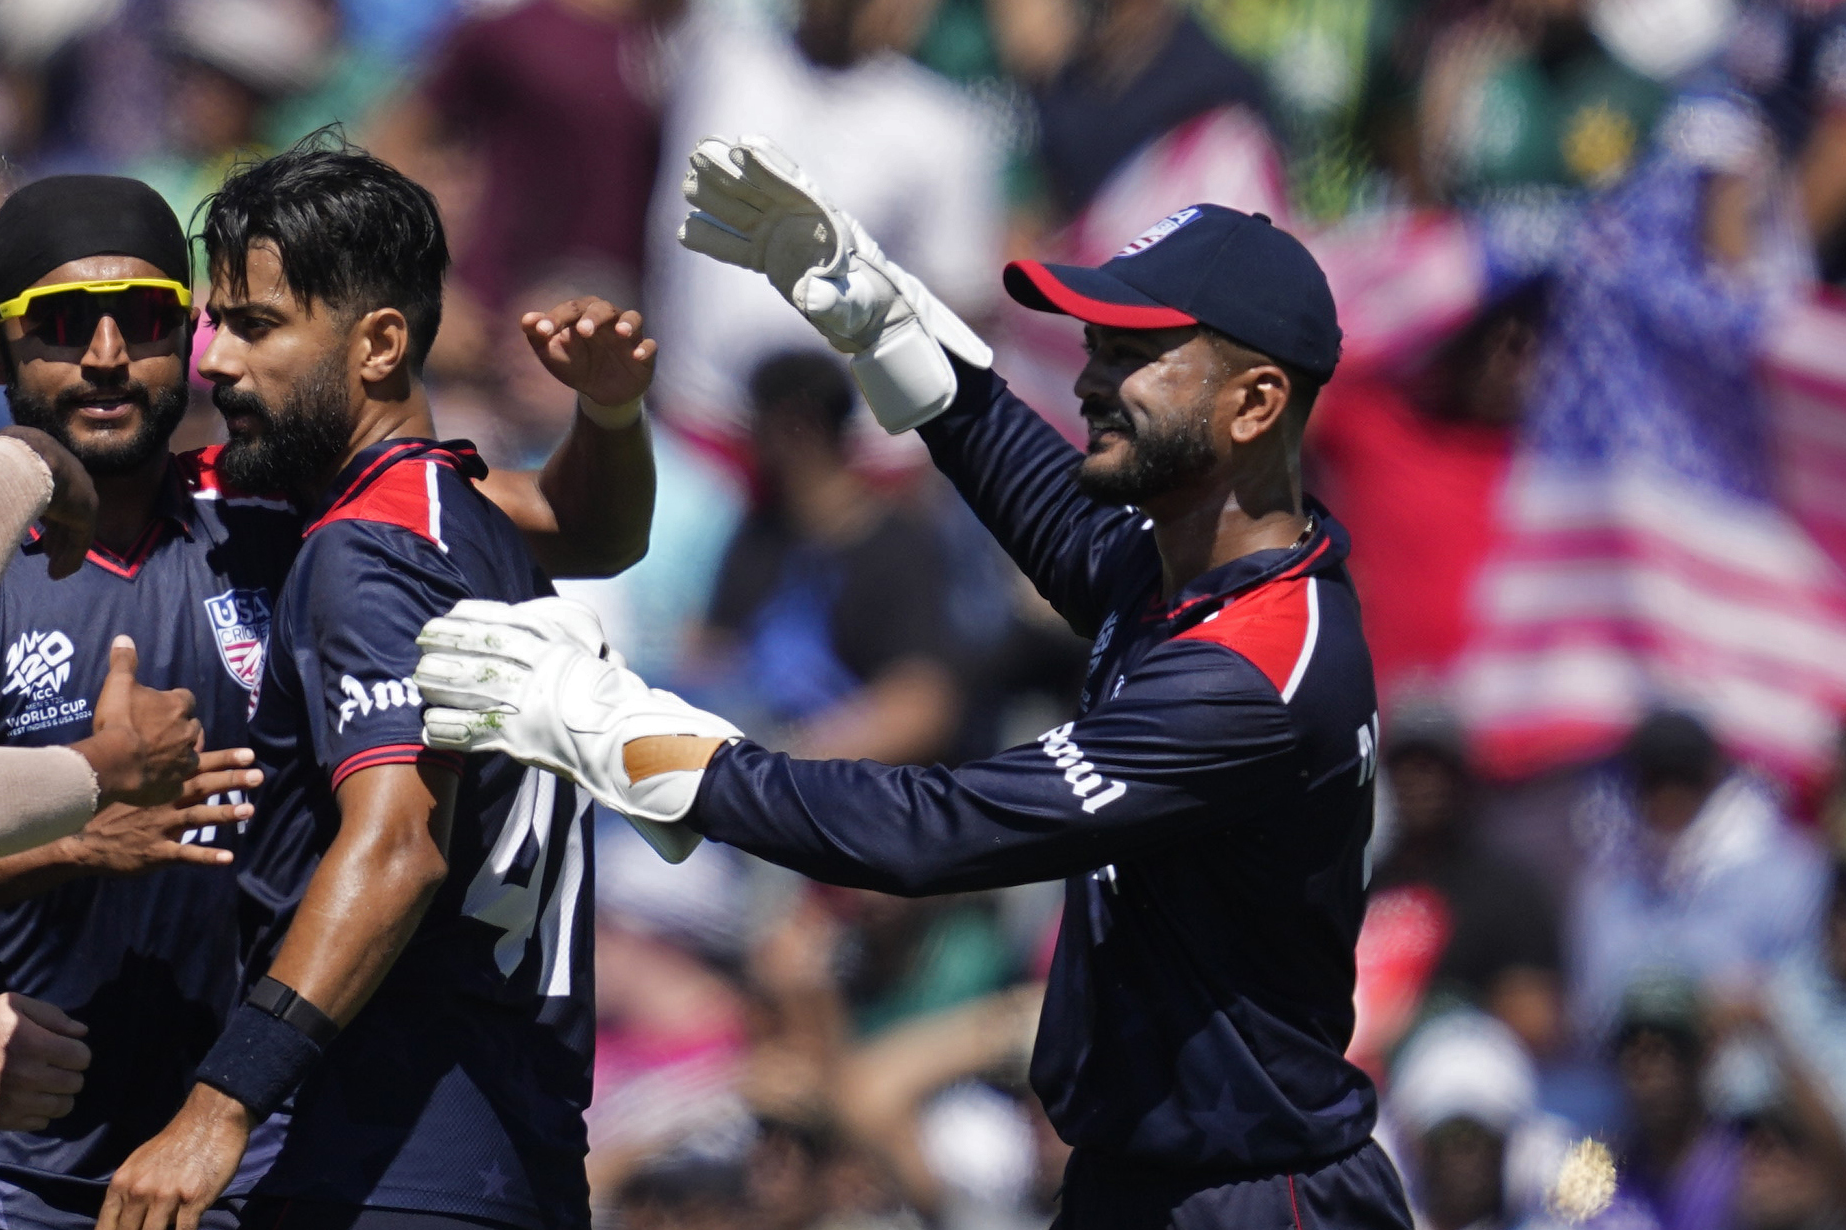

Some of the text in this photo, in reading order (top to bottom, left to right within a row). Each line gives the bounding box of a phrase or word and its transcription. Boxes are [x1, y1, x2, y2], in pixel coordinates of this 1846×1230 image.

[211, 596, 272, 628] USA
[33, 687, 54, 701] ICC
[6, 699, 87, 728] WORLD CUP
[59, 715, 74, 724] USA
[74, 710, 93, 720] 2024
